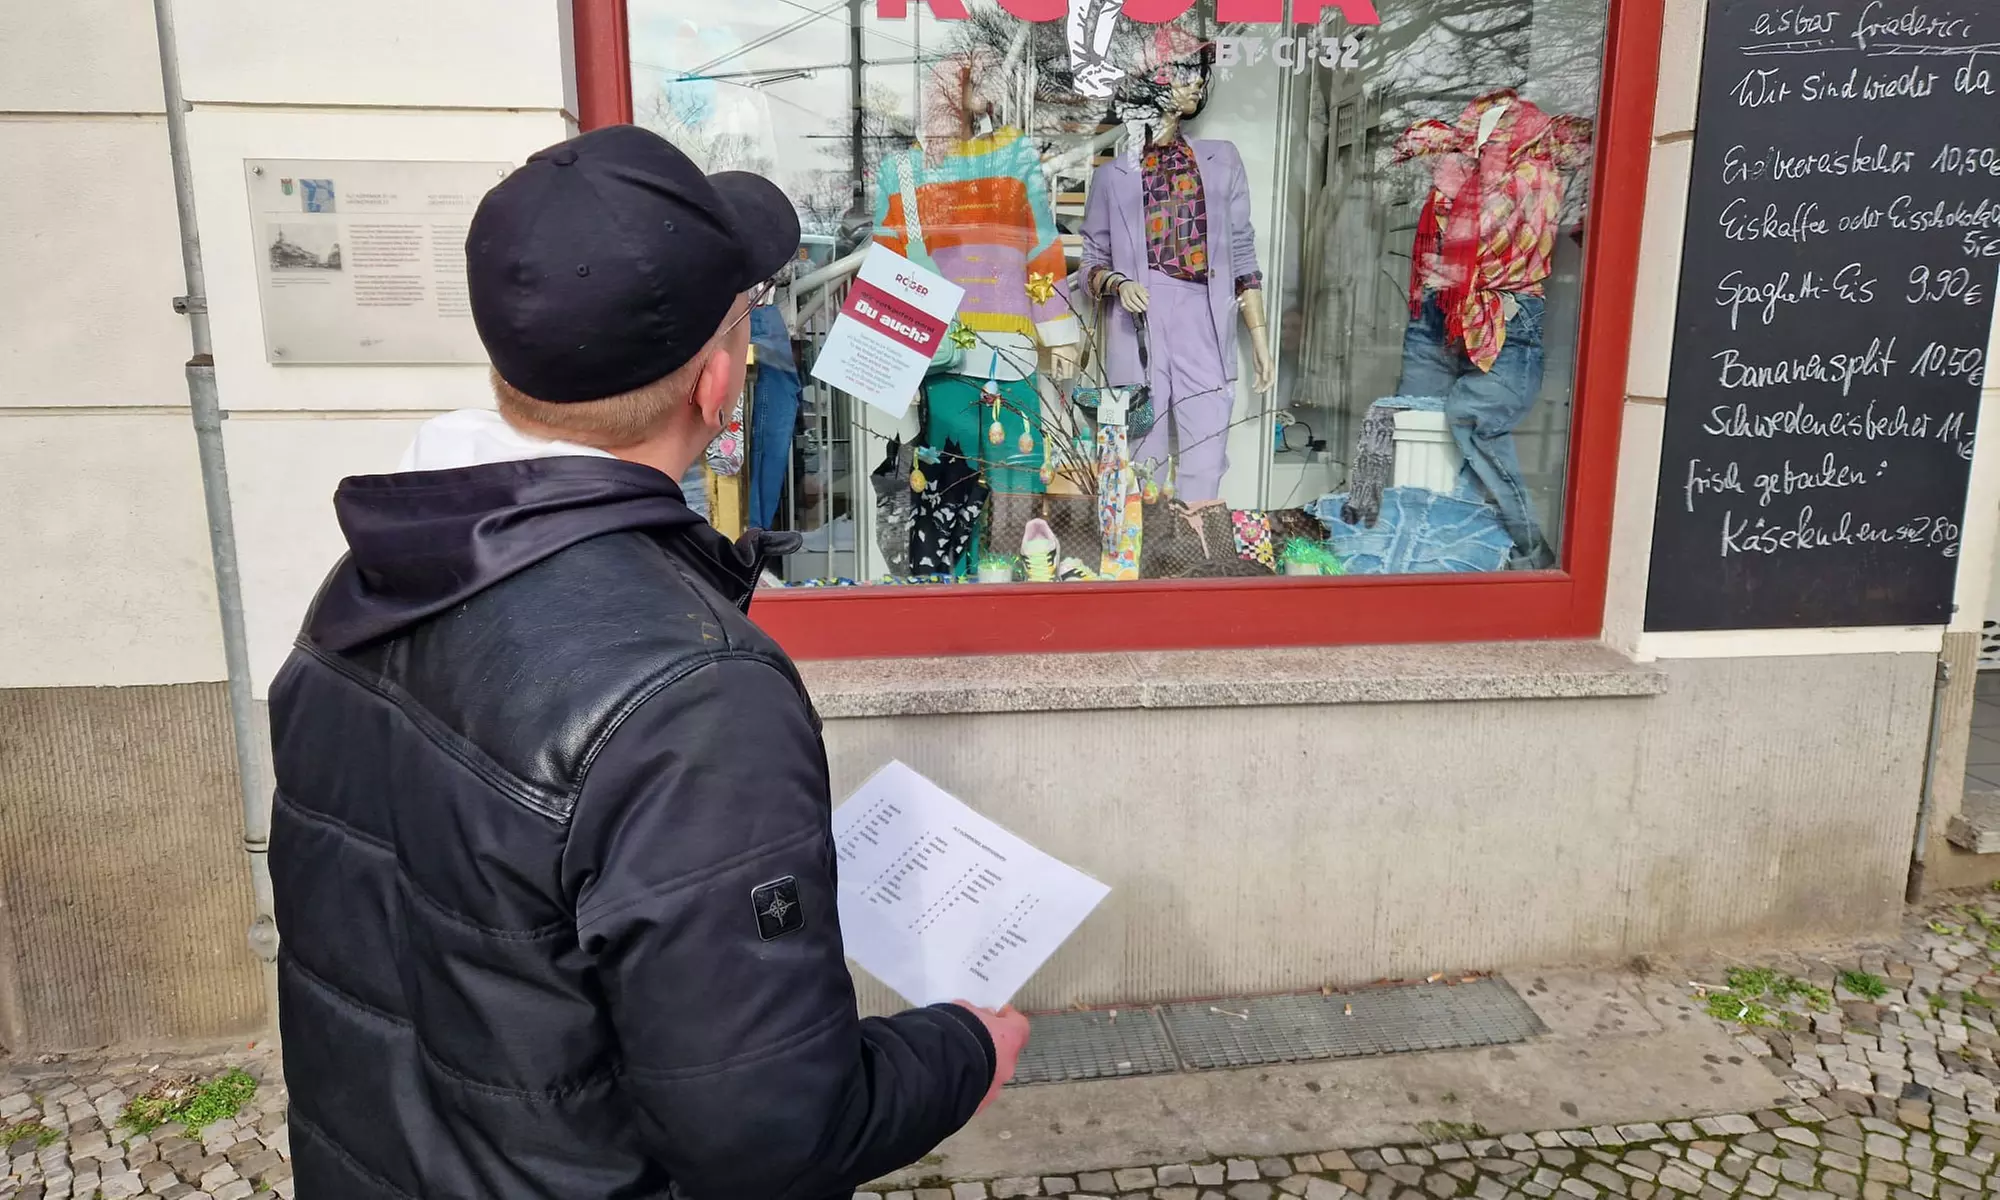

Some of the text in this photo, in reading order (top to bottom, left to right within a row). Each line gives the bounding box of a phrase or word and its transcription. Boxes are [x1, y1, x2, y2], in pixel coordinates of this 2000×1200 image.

[1216, 37, 1263, 67] BY
[1730, 67, 1791, 107] Wir
[1863, 66, 1938, 101] wieder
[1954, 52, 1995, 94] da
[1719, 198, 1829, 242] Eiskaffee
[1838, 206, 1884, 231] oder
[854, 299, 931, 344] Du auch?
[1715, 263, 1878, 329] Spaghetti-Eis
[1712, 337, 1897, 396] Bananensplit
[1702, 400, 1932, 439] Schwedeneisbecher
[1684, 458, 1745, 512] frisch
[1721, 505, 1894, 557] Käsekuchen
